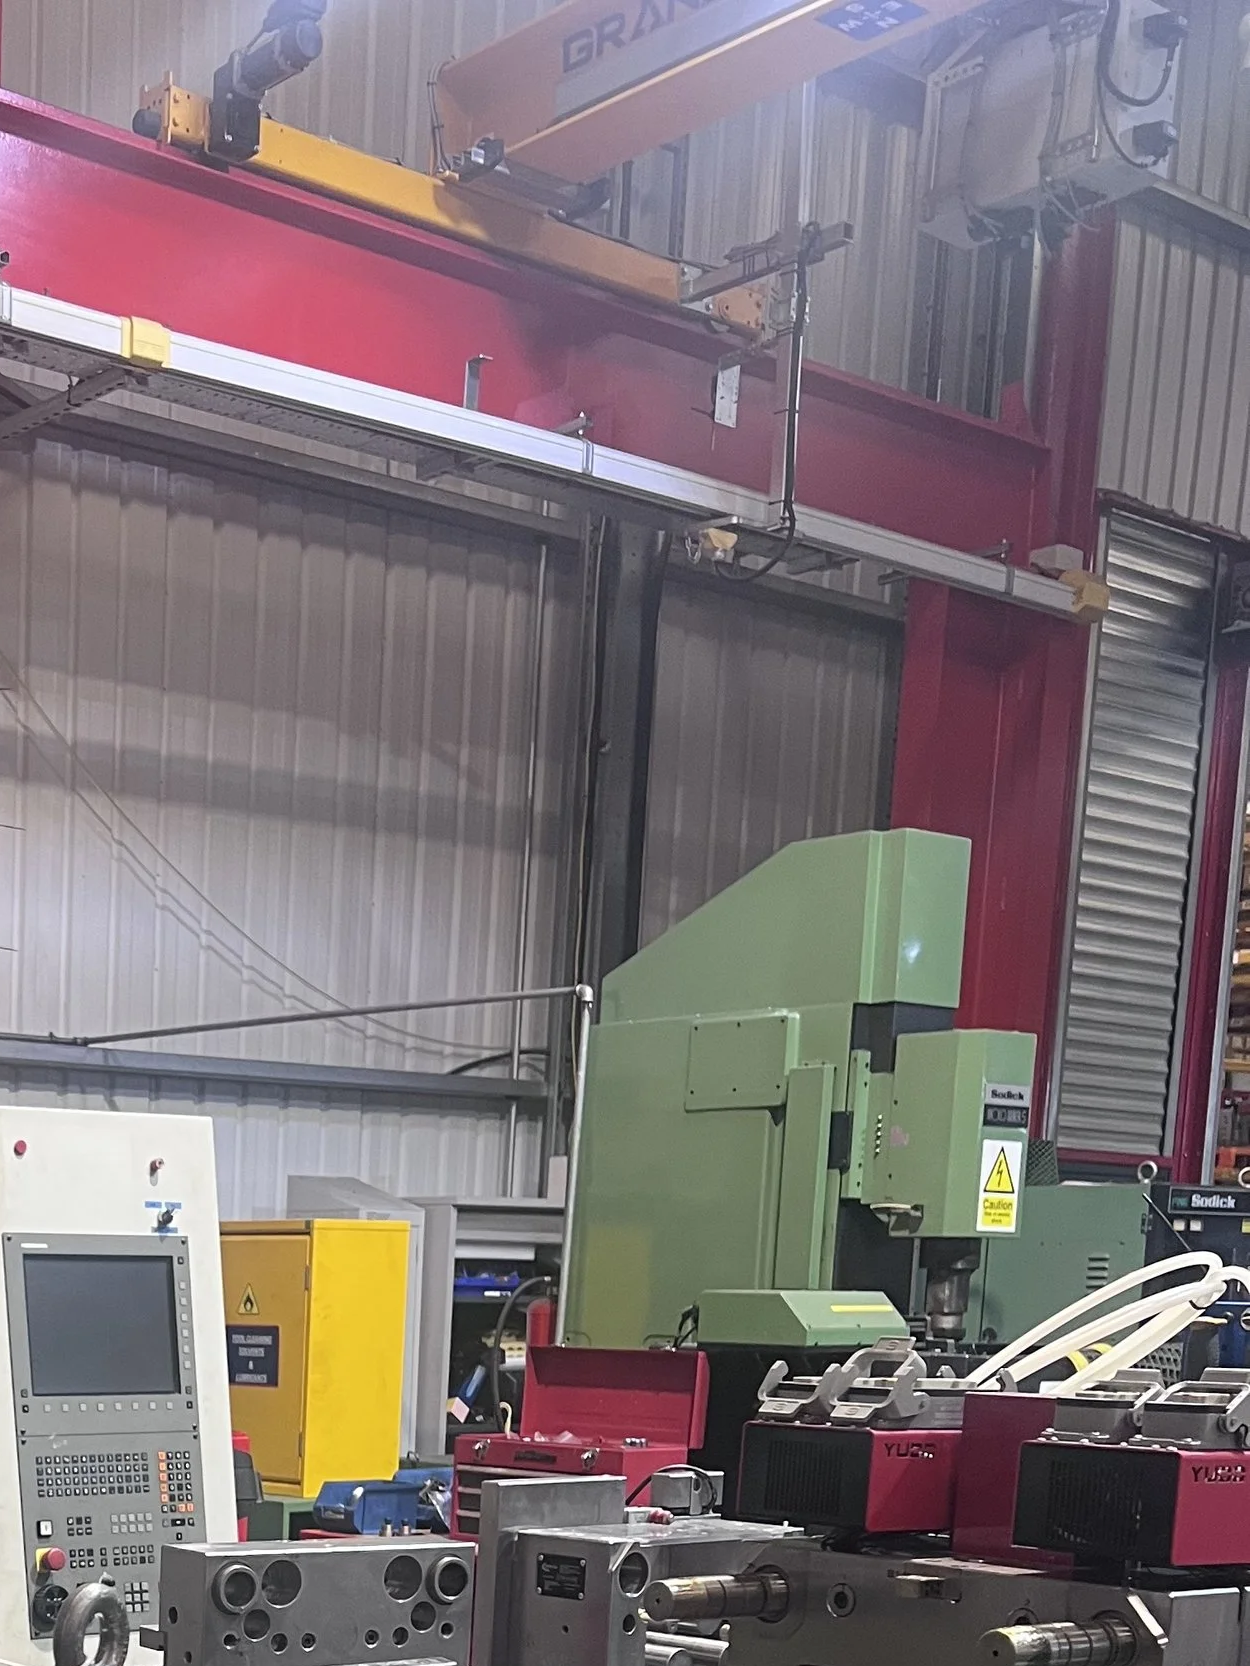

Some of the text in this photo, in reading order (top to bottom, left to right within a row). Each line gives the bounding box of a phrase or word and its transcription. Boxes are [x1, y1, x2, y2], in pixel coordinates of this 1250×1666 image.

[991, 1089, 1024, 1101] Sodick
[982, 1198, 1013, 1210] Caution
[1191, 1193, 1236, 1209] Sodick
